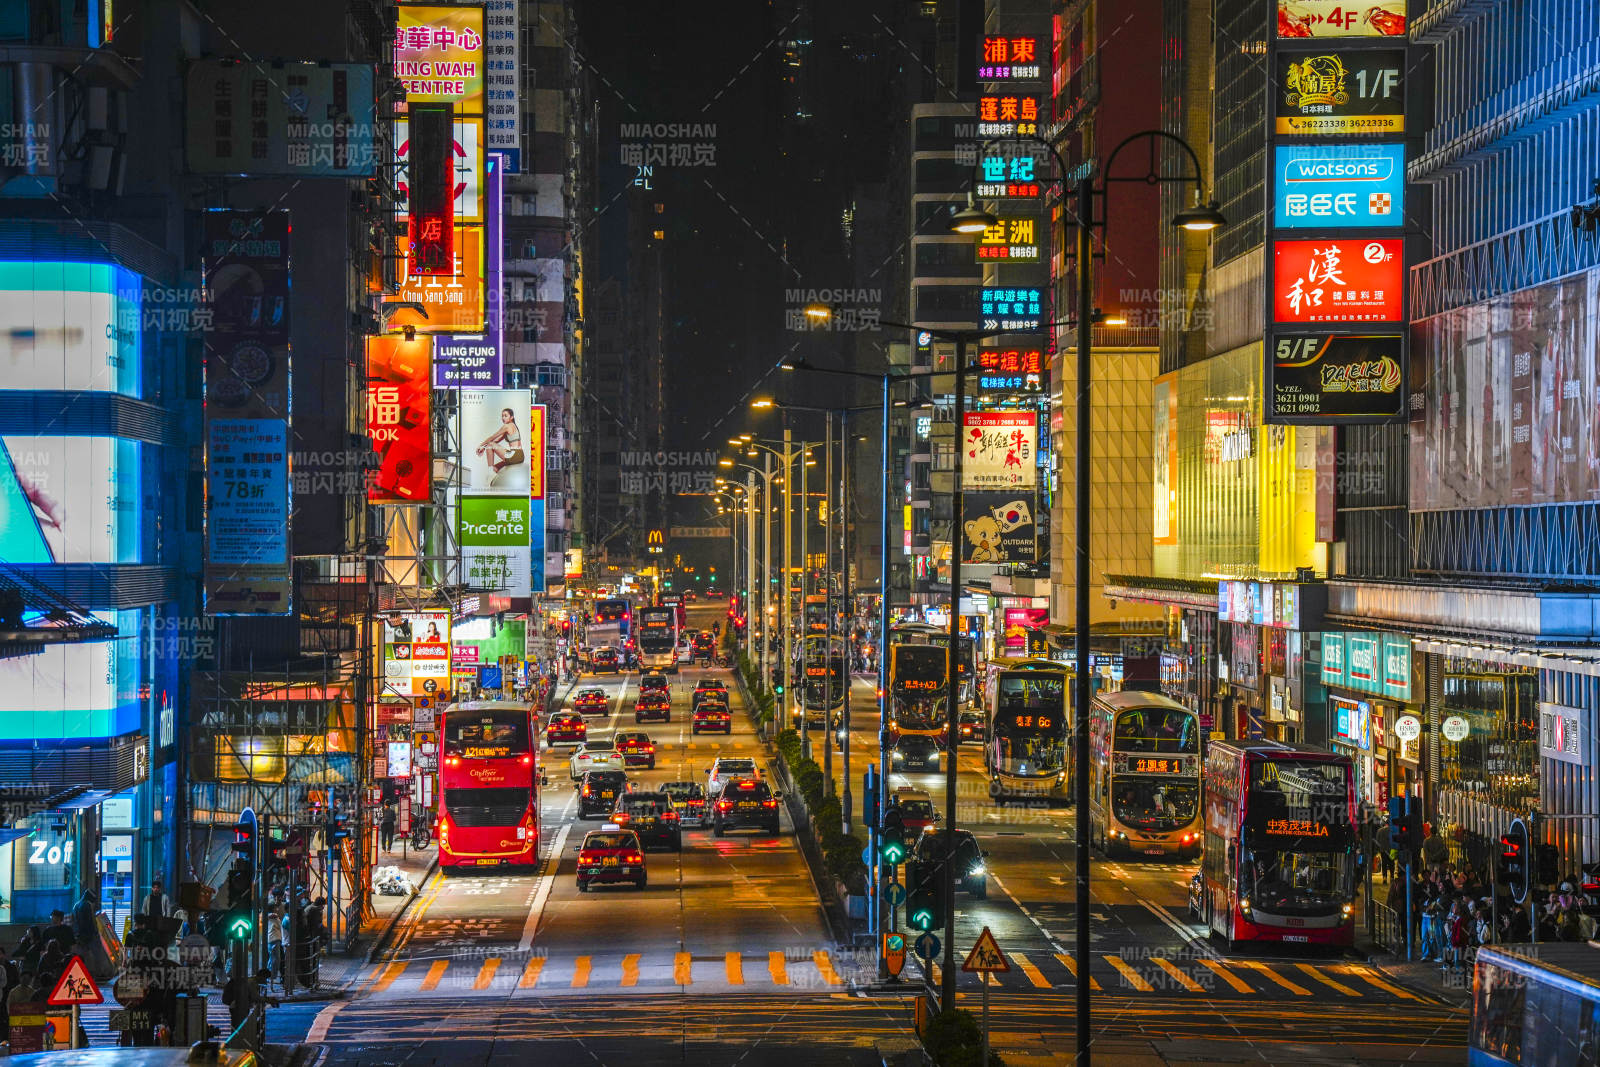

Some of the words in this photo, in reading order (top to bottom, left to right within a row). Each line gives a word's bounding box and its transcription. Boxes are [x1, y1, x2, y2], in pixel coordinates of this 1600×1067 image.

[1327, 7, 1358, 30] 4F
[984, 37, 1036, 62] 浦東
[397, 61, 431, 76] ING
[434, 61, 476, 77] WAH
[1356, 69, 1399, 98] 1/F
[981, 97, 1038, 121] 蓬萊島
[1302, 105, 1333, 114] 日本料理
[1302, 120, 1346, 128] 36223338
[1349, 119, 1394, 127] 36223336
[982, 158, 1035, 182] 世紀
[1299, 163, 1378, 177] watsons
[1008, 185, 1039, 196] 夜總會
[1286, 193, 1357, 217] 屈臣氏
[421, 218, 442, 241] 店
[981, 220, 1034, 244] 亞洲
[1368, 245, 1393, 261] 2/F
[402, 290, 423, 303] Chow
[424, 289, 443, 305] Sang
[444, 289, 463, 305] Sang
[440, 346, 467, 356] LUNG
[468, 346, 496, 356] FUNG
[1276, 339, 1318, 359] 5/F
[980, 351, 1041, 374] 新輝煌
[445, 371, 470, 379] SINCE
[472, 371, 491, 379] 1992
[980, 377, 1022, 388] 電梯按4字
[1276, 393, 1297, 403] 3621
[1298, 392, 1320, 402] 0901
[1276, 404, 1297, 413] 3621
[1298, 403, 1320, 413] 0902
[224, 481, 265, 499] 78折
[495, 509, 523, 522] 實惠
[461, 521, 524, 535] Pricerite
[465, 747, 477, 757] A21
[1173, 760, 1180, 773] 1
[1313, 821, 1329, 837] 1A
[28, 840, 74, 865] Zoff
[132, 1011, 149, 1019] MK
